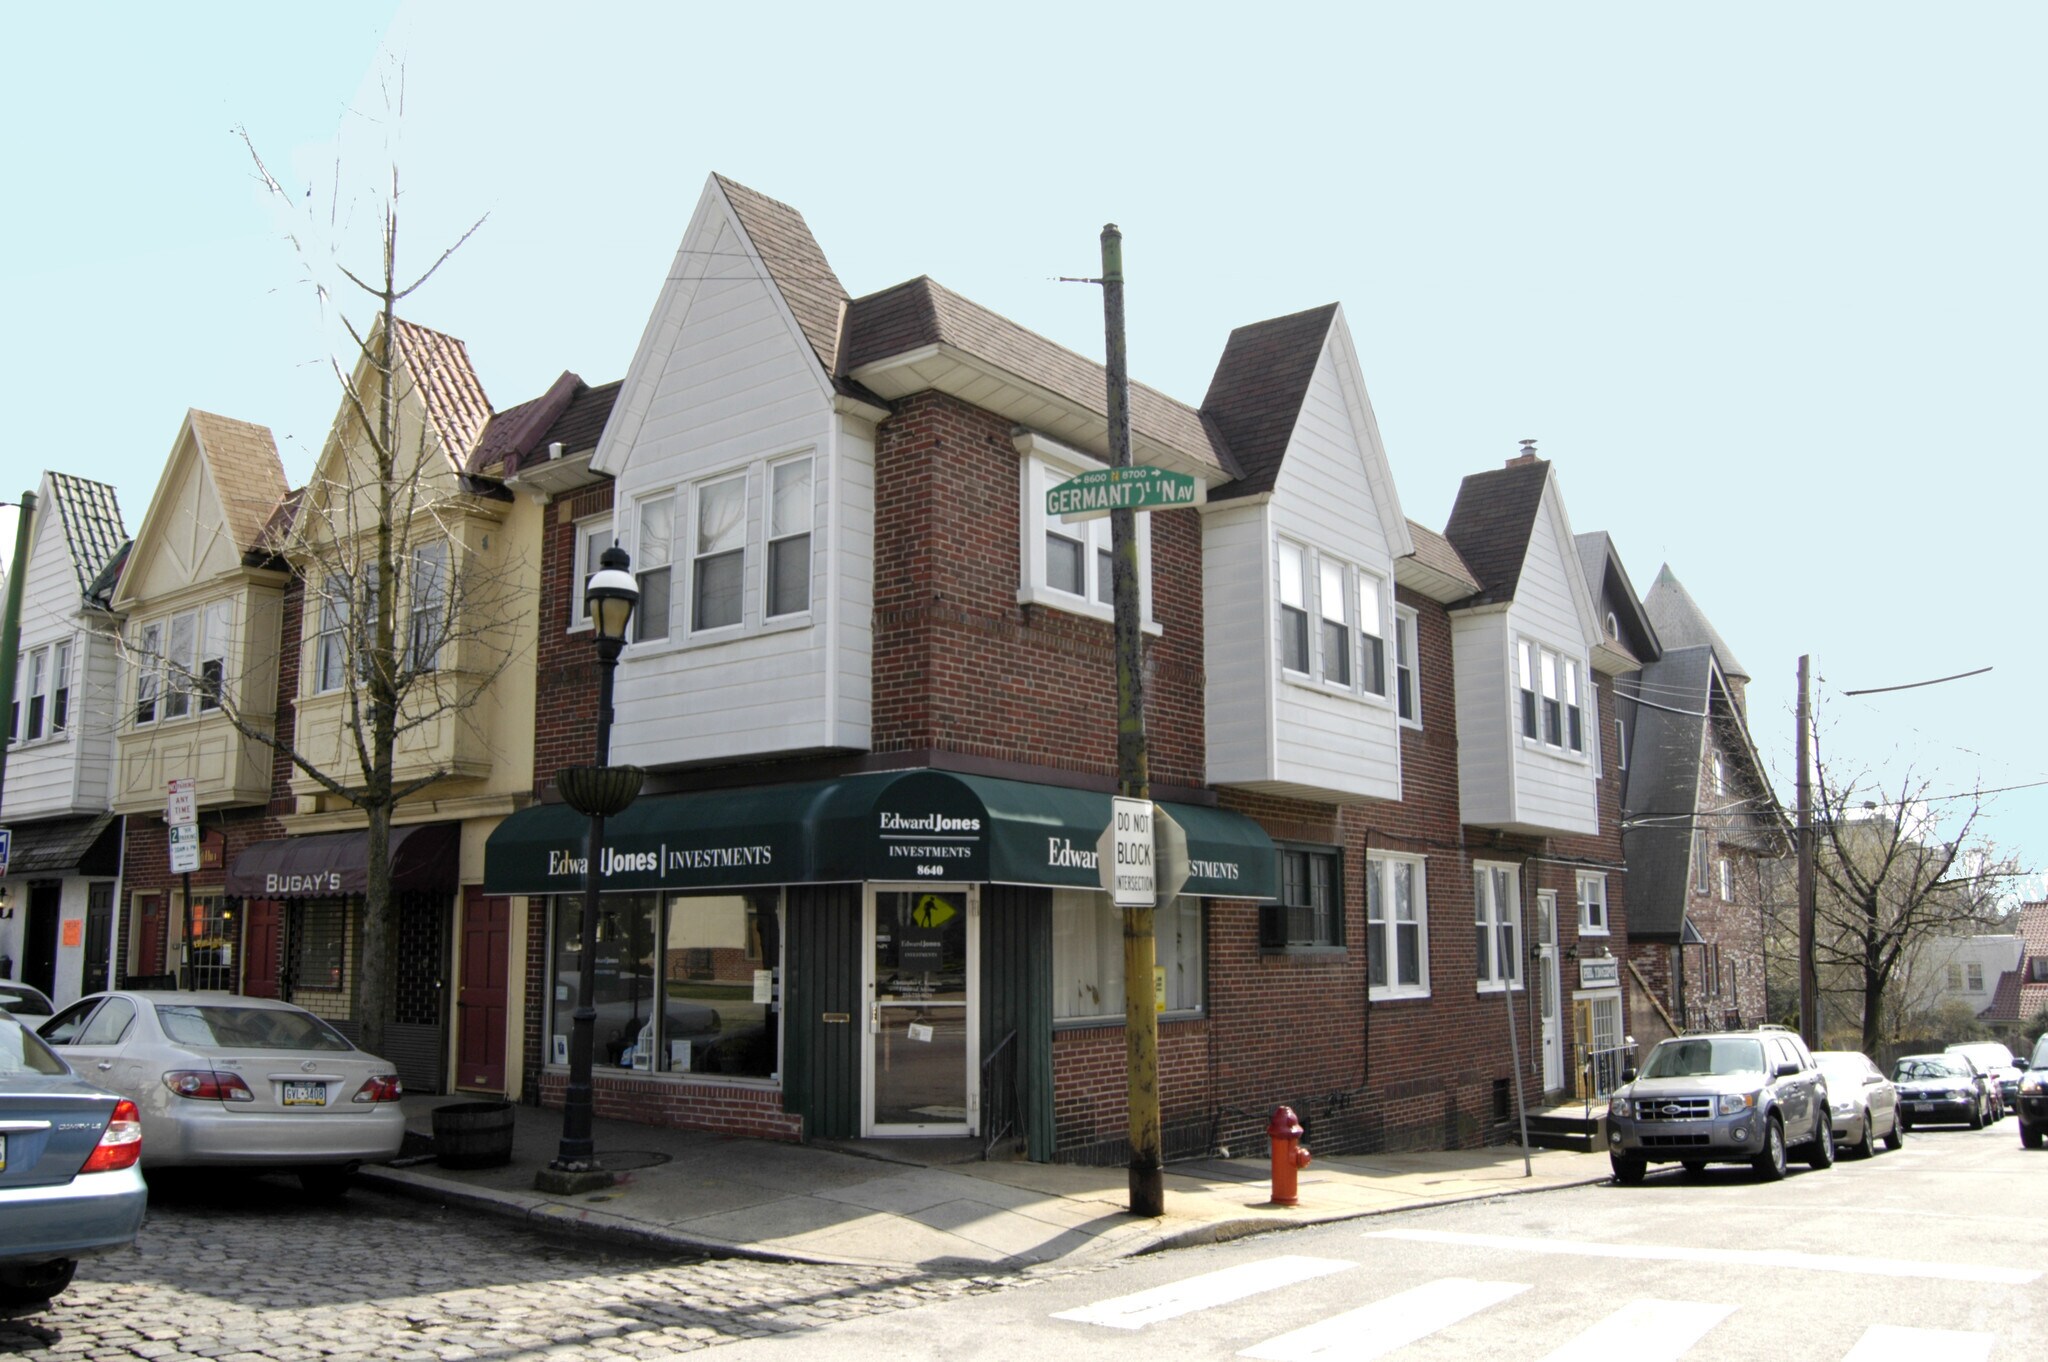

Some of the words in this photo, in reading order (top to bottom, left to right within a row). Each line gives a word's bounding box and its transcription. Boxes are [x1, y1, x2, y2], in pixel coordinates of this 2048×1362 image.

[1083, 473, 1107, 484] 8600
[1122, 469, 1147, 480] 8700
[1048, 479, 1175, 513] GERMANTN
[1177, 485, 1193, 501] AV
[176, 796, 189, 804] ANY
[175, 805, 191, 814] TIME
[1117, 812, 1130, 832] DO
[1133, 813, 1150, 833] NOT
[171, 828, 178, 842] 2
[669, 845, 772, 869] INVESTMENTS
[889, 845, 971, 858] INVESTMENTS
[1117, 841, 1151, 866] BLOCK
[917, 864, 944, 876] 8640
[1188, 859, 1239, 879] STMENTS
[265, 870, 341, 893] BUGAY'S
[1116, 875, 1153, 891] INTERSECTION
